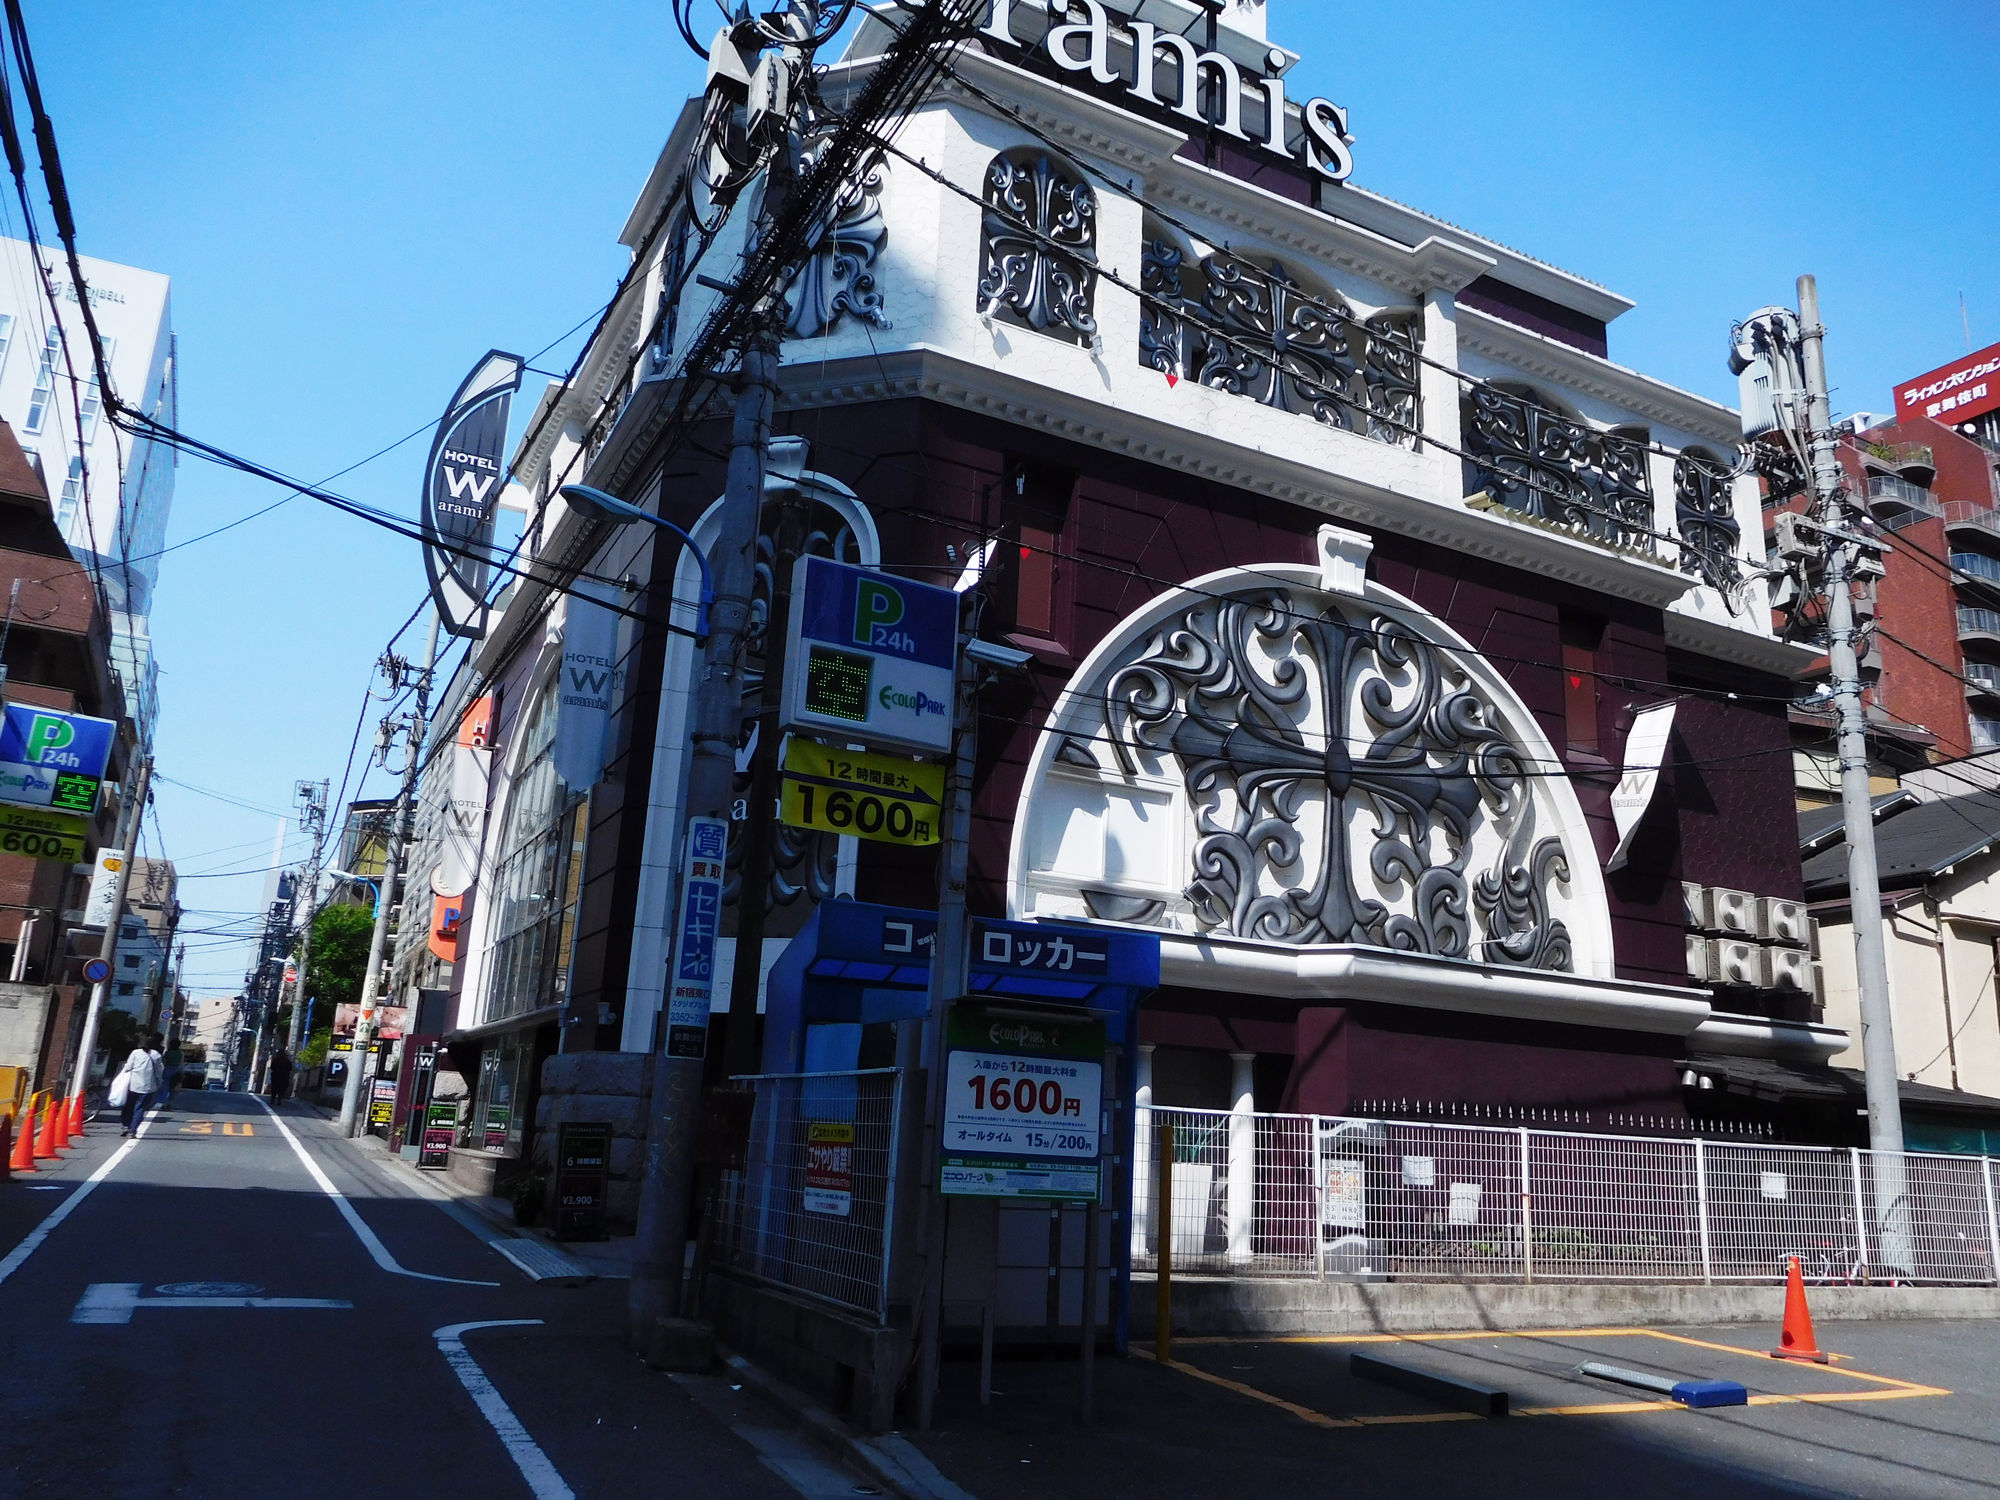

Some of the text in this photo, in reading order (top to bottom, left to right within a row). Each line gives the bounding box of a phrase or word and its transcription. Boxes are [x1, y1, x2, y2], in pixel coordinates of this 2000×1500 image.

[444, 449, 498, 471] HOTEL
[443, 465, 497, 503] W
[853, 577, 905, 646] P
[874, 628, 915, 654] 24h
[565, 652, 613, 668] HOTEL
[568, 667, 609, 694] W
[806, 656, 869, 722] 空
[563, 695, 609, 711] aramis
[24, 714, 75, 763] P
[44, 750, 80, 768] 24h
[52, 775, 97, 811] 空
[1620, 774, 1652, 795] W
[453, 810, 480, 828] W
[798, 785, 930, 842] 1600円
[691, 861, 722, 879] 買取
[332, 1063, 343, 1075] P
[968, 1075, 1081, 1116] 1600円
[958, 1130, 1012, 1142] オールタイム
